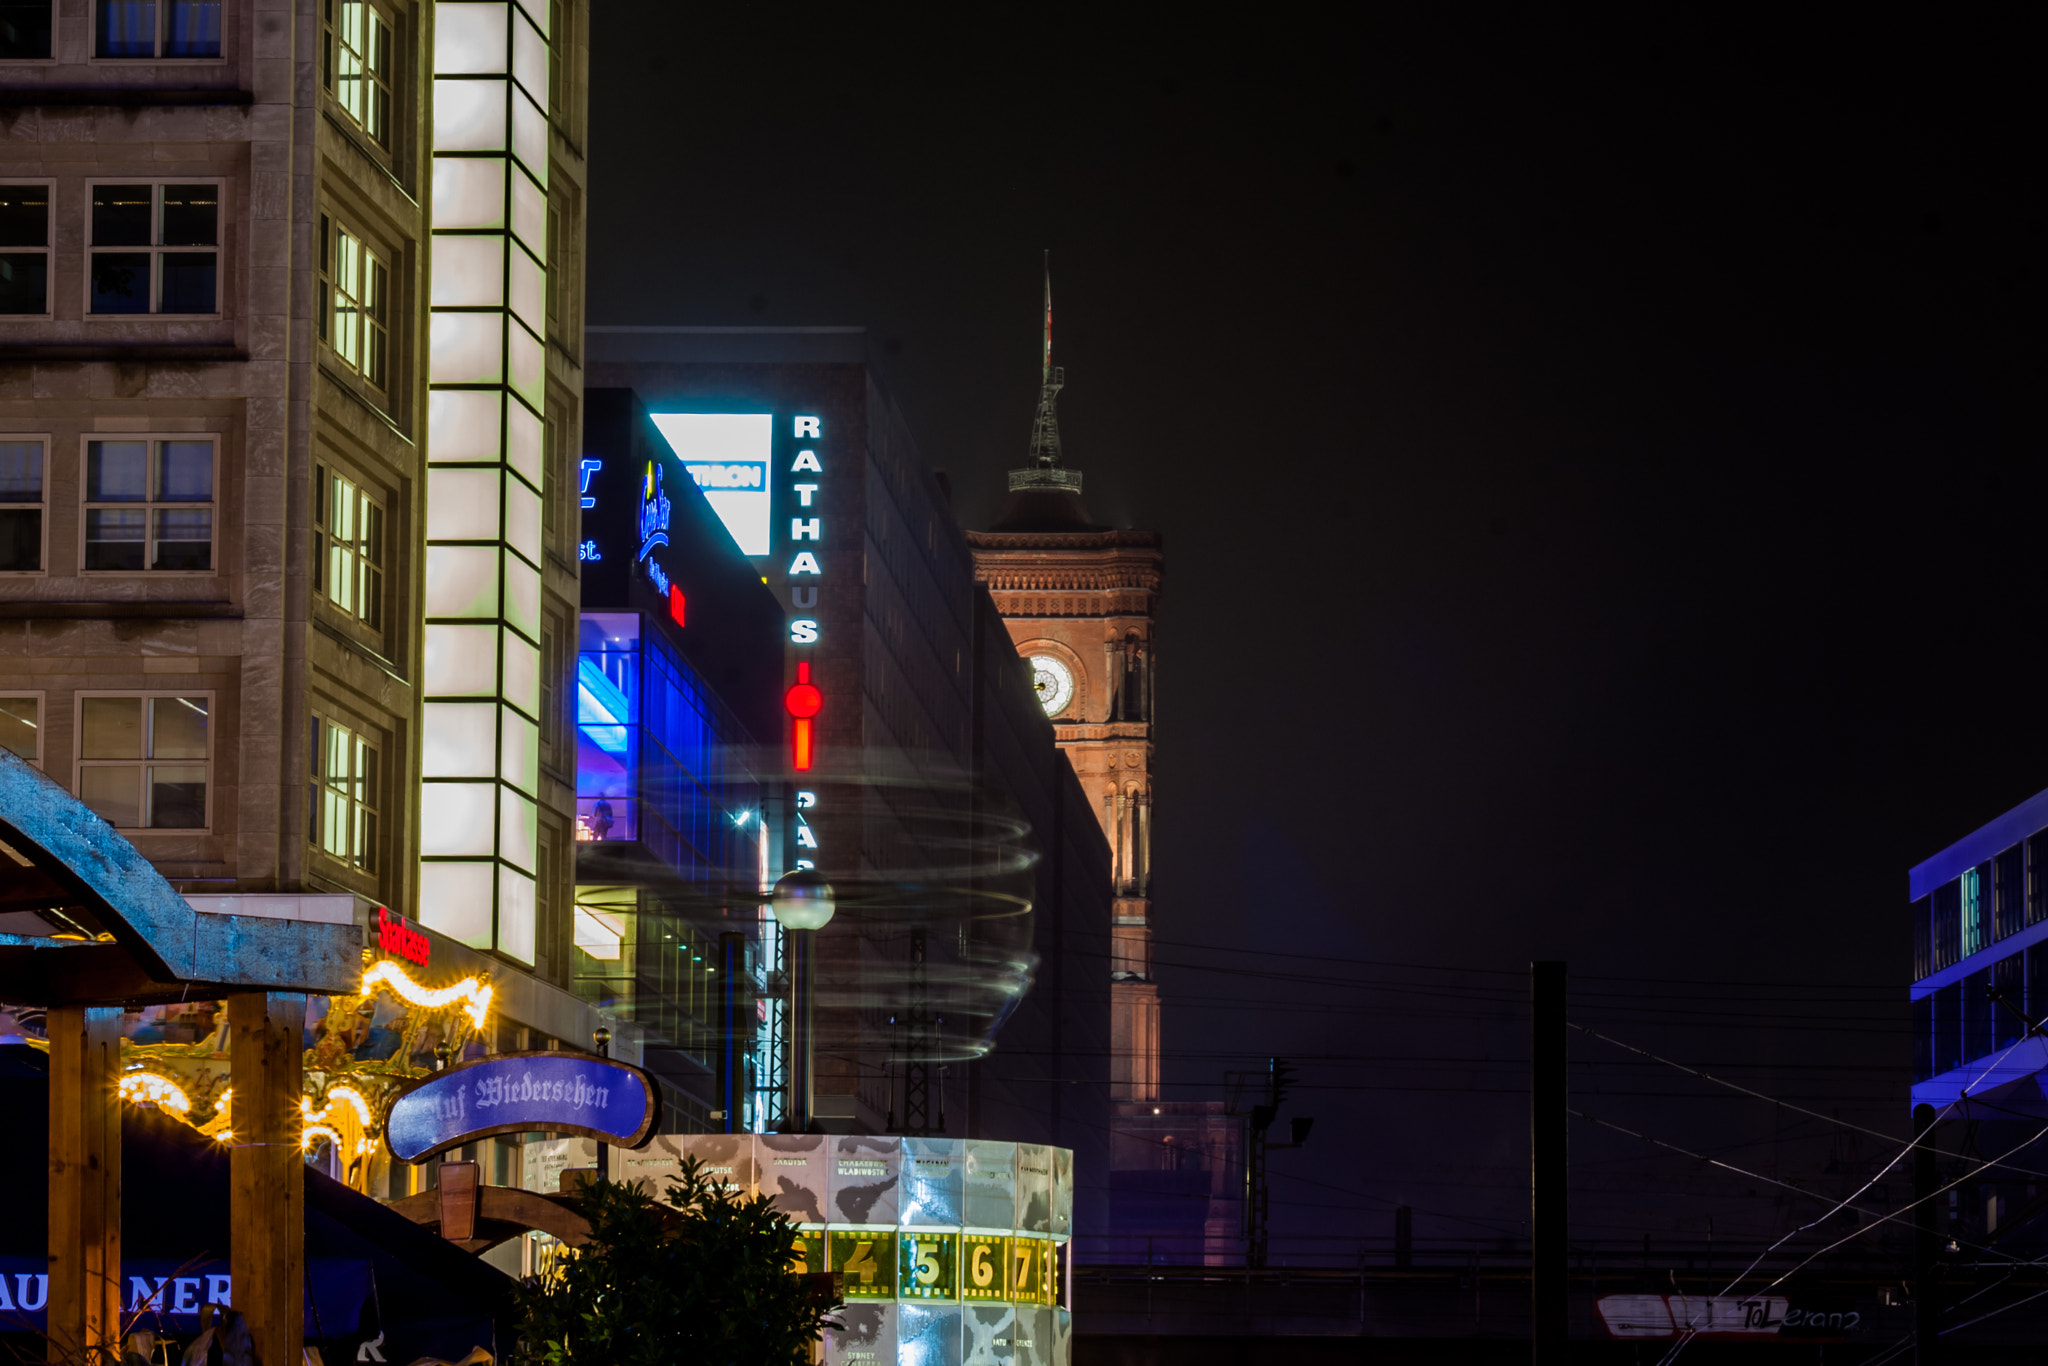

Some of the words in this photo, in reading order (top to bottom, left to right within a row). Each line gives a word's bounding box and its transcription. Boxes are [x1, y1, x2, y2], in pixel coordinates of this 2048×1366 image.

[789, 415, 824, 646] RATHAUS
[475, 1071, 610, 1111] Wiedersehen
[844, 1241, 878, 1282] 4
[914, 1243, 940, 1285] 5
[972, 1245, 993, 1287] 6
[1015, 1248, 1031, 1288] 7
[847, 1351, 875, 1360] SYDNEY
